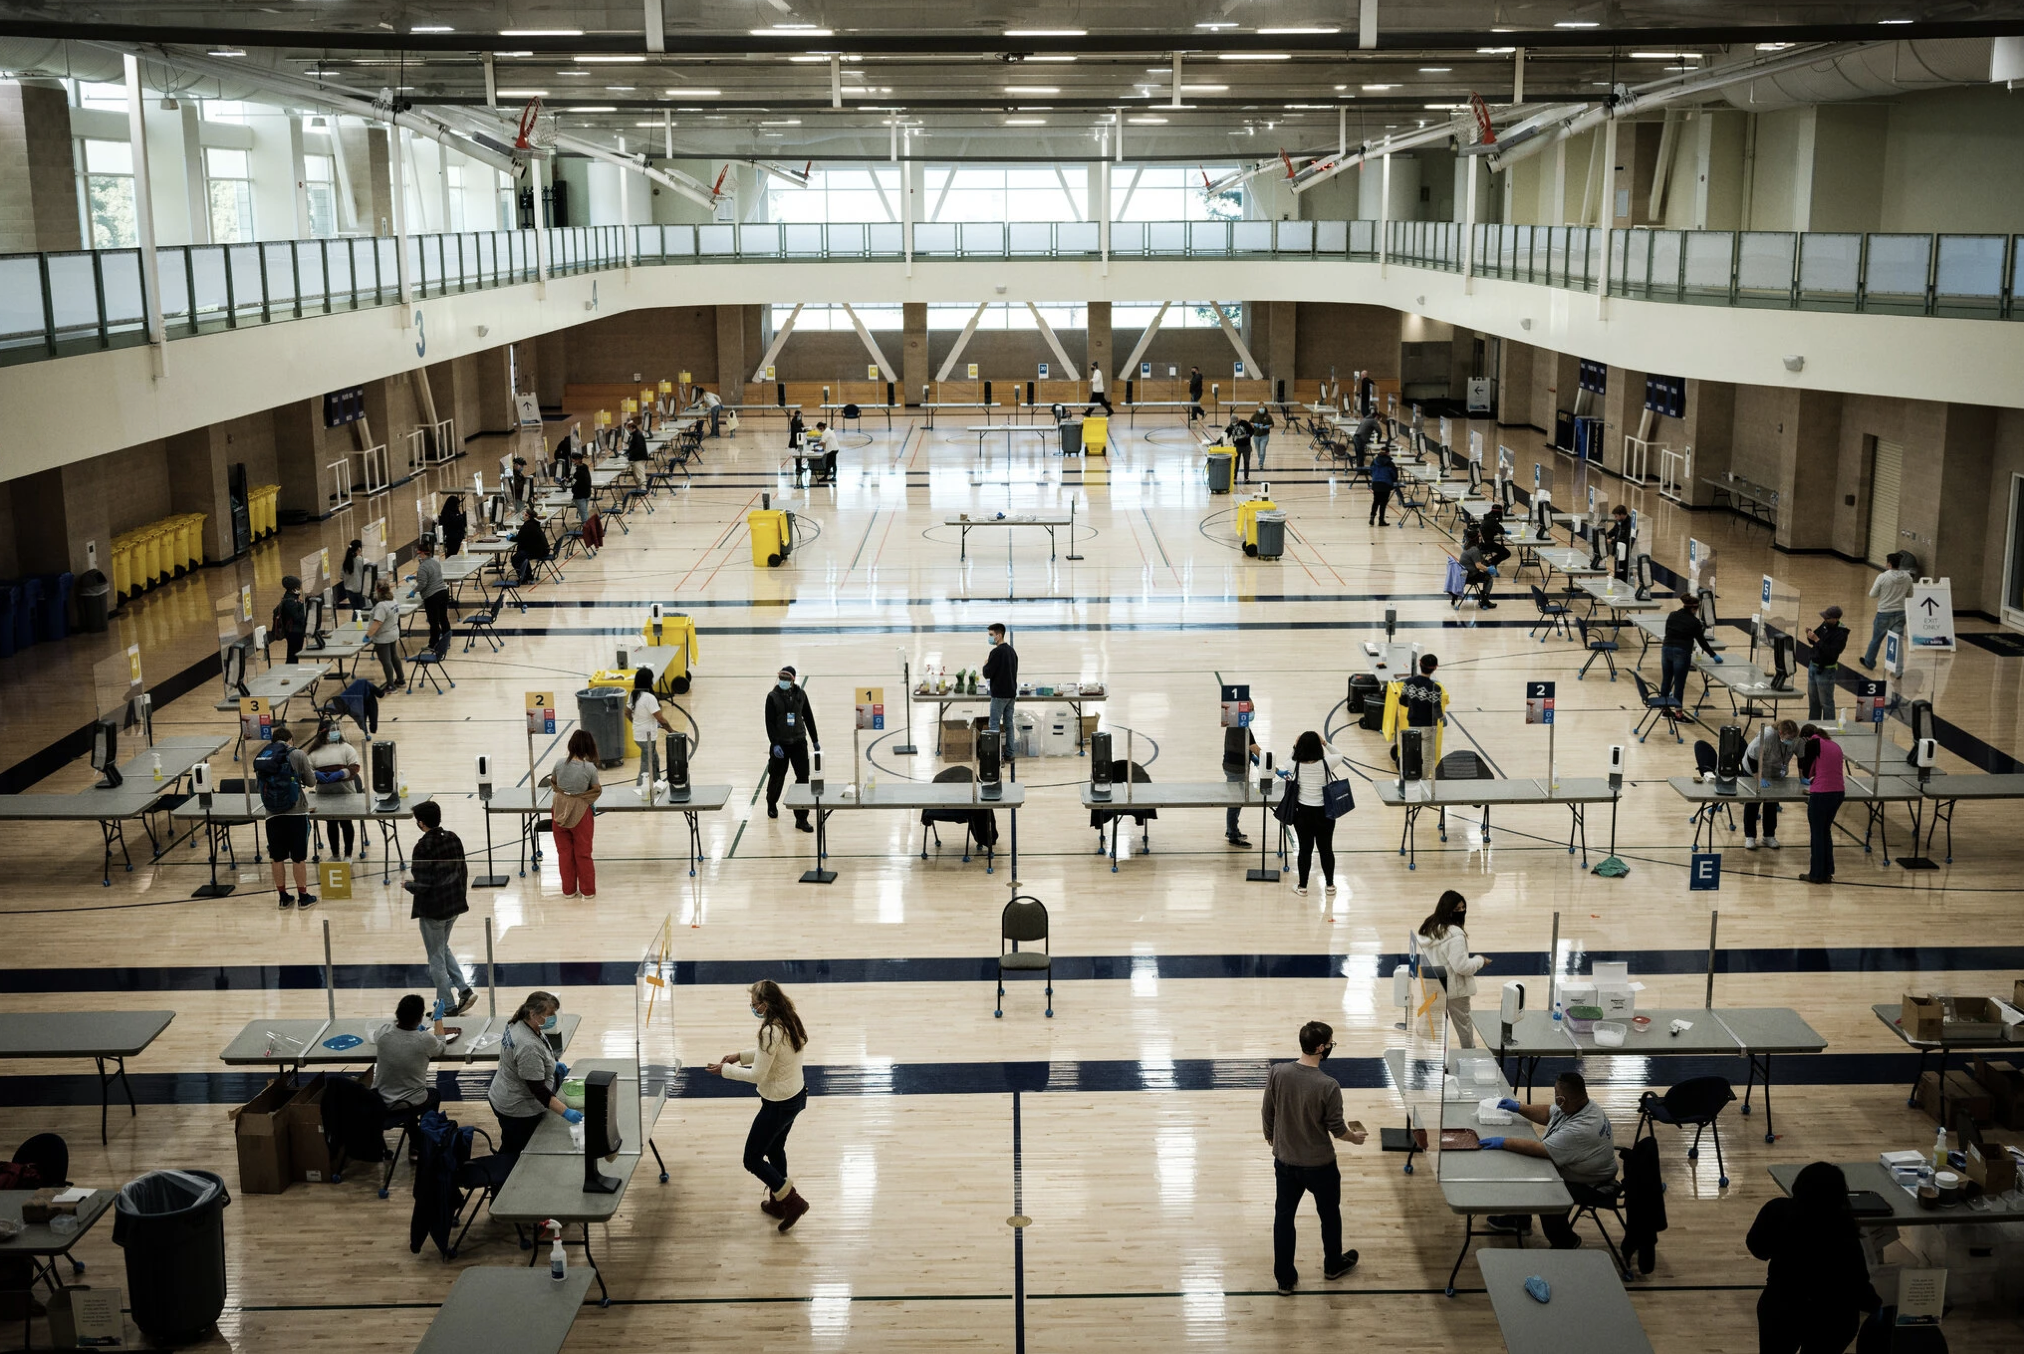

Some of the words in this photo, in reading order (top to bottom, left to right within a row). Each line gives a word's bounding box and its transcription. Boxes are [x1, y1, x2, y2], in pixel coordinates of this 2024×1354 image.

[415, 310, 426, 358] 3
[1764, 584, 1769, 596] 5
[1889, 641, 1894, 655] 4
[132, 657, 137, 670] 4
[1231, 688, 1238, 699] 1
[1536, 684, 1546, 696] 2
[1867, 683, 1877, 695] 3
[535, 694, 545, 706] 2
[866, 691, 872, 702] 1
[250, 700, 259, 712] 3
[1699, 860, 1713, 879] E
[329, 869, 343, 888] E
